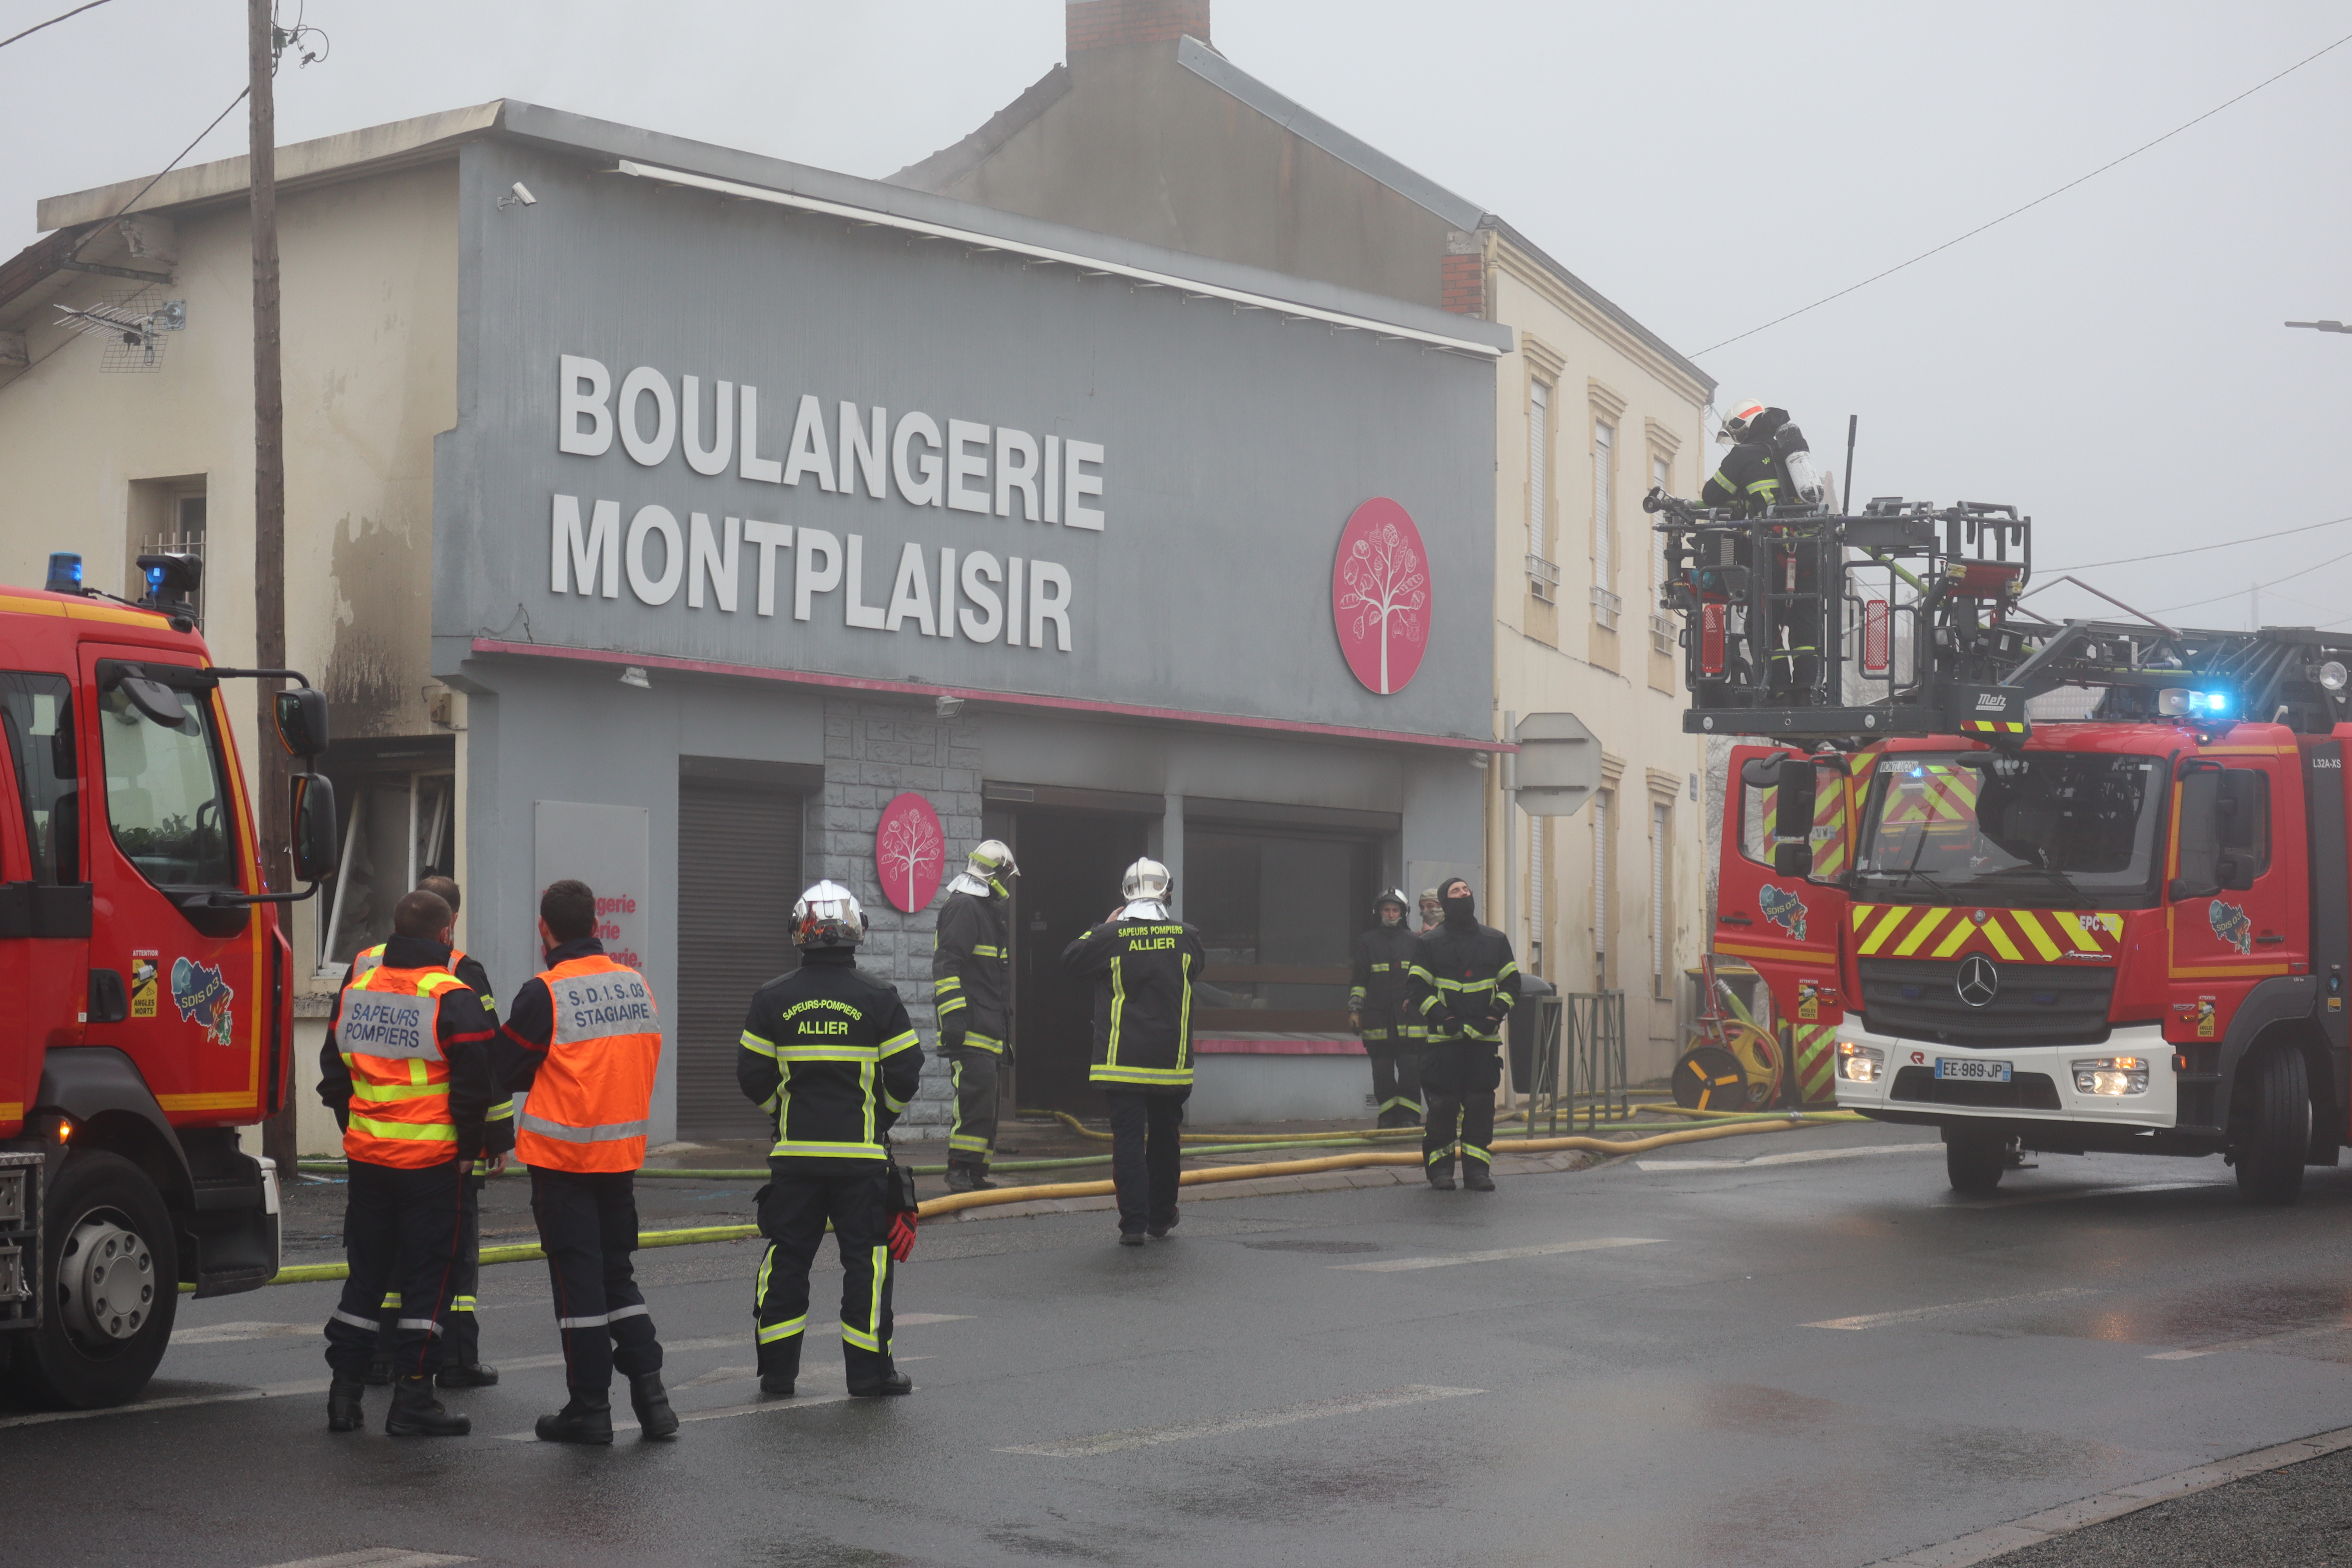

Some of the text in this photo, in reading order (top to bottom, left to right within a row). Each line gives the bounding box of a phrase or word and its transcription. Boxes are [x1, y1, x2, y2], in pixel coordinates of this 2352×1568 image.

[559, 354, 1104, 531] BOULANGERIE
[552, 494, 1072, 651] MONTPLAISIR
[1978, 694, 2006, 705] Metz
[2313, 759, 2341, 768] L32A-XS
[1767, 898, 1797, 915] SDIS 03
[2080, 916, 2116, 931] EPC 32
[2217, 912, 2241, 931] SDIS 03
[1118, 926, 1183, 937] SAPEURS POMPIERS
[1129, 938, 1175, 951] ALLIER
[181, 977, 220, 1008] SDIS 03
[352, 1003, 419, 1027] SAPEURS
[575, 1003, 649, 1028] STAGIAIRE
[782, 1000, 862, 1021] SAPEURS-POMPIERS
[345, 1023, 419, 1048] POMPIERS
[797, 1021, 848, 1035] ALLIER
[1943, 1062, 2002, 1078] EE-989-JP
